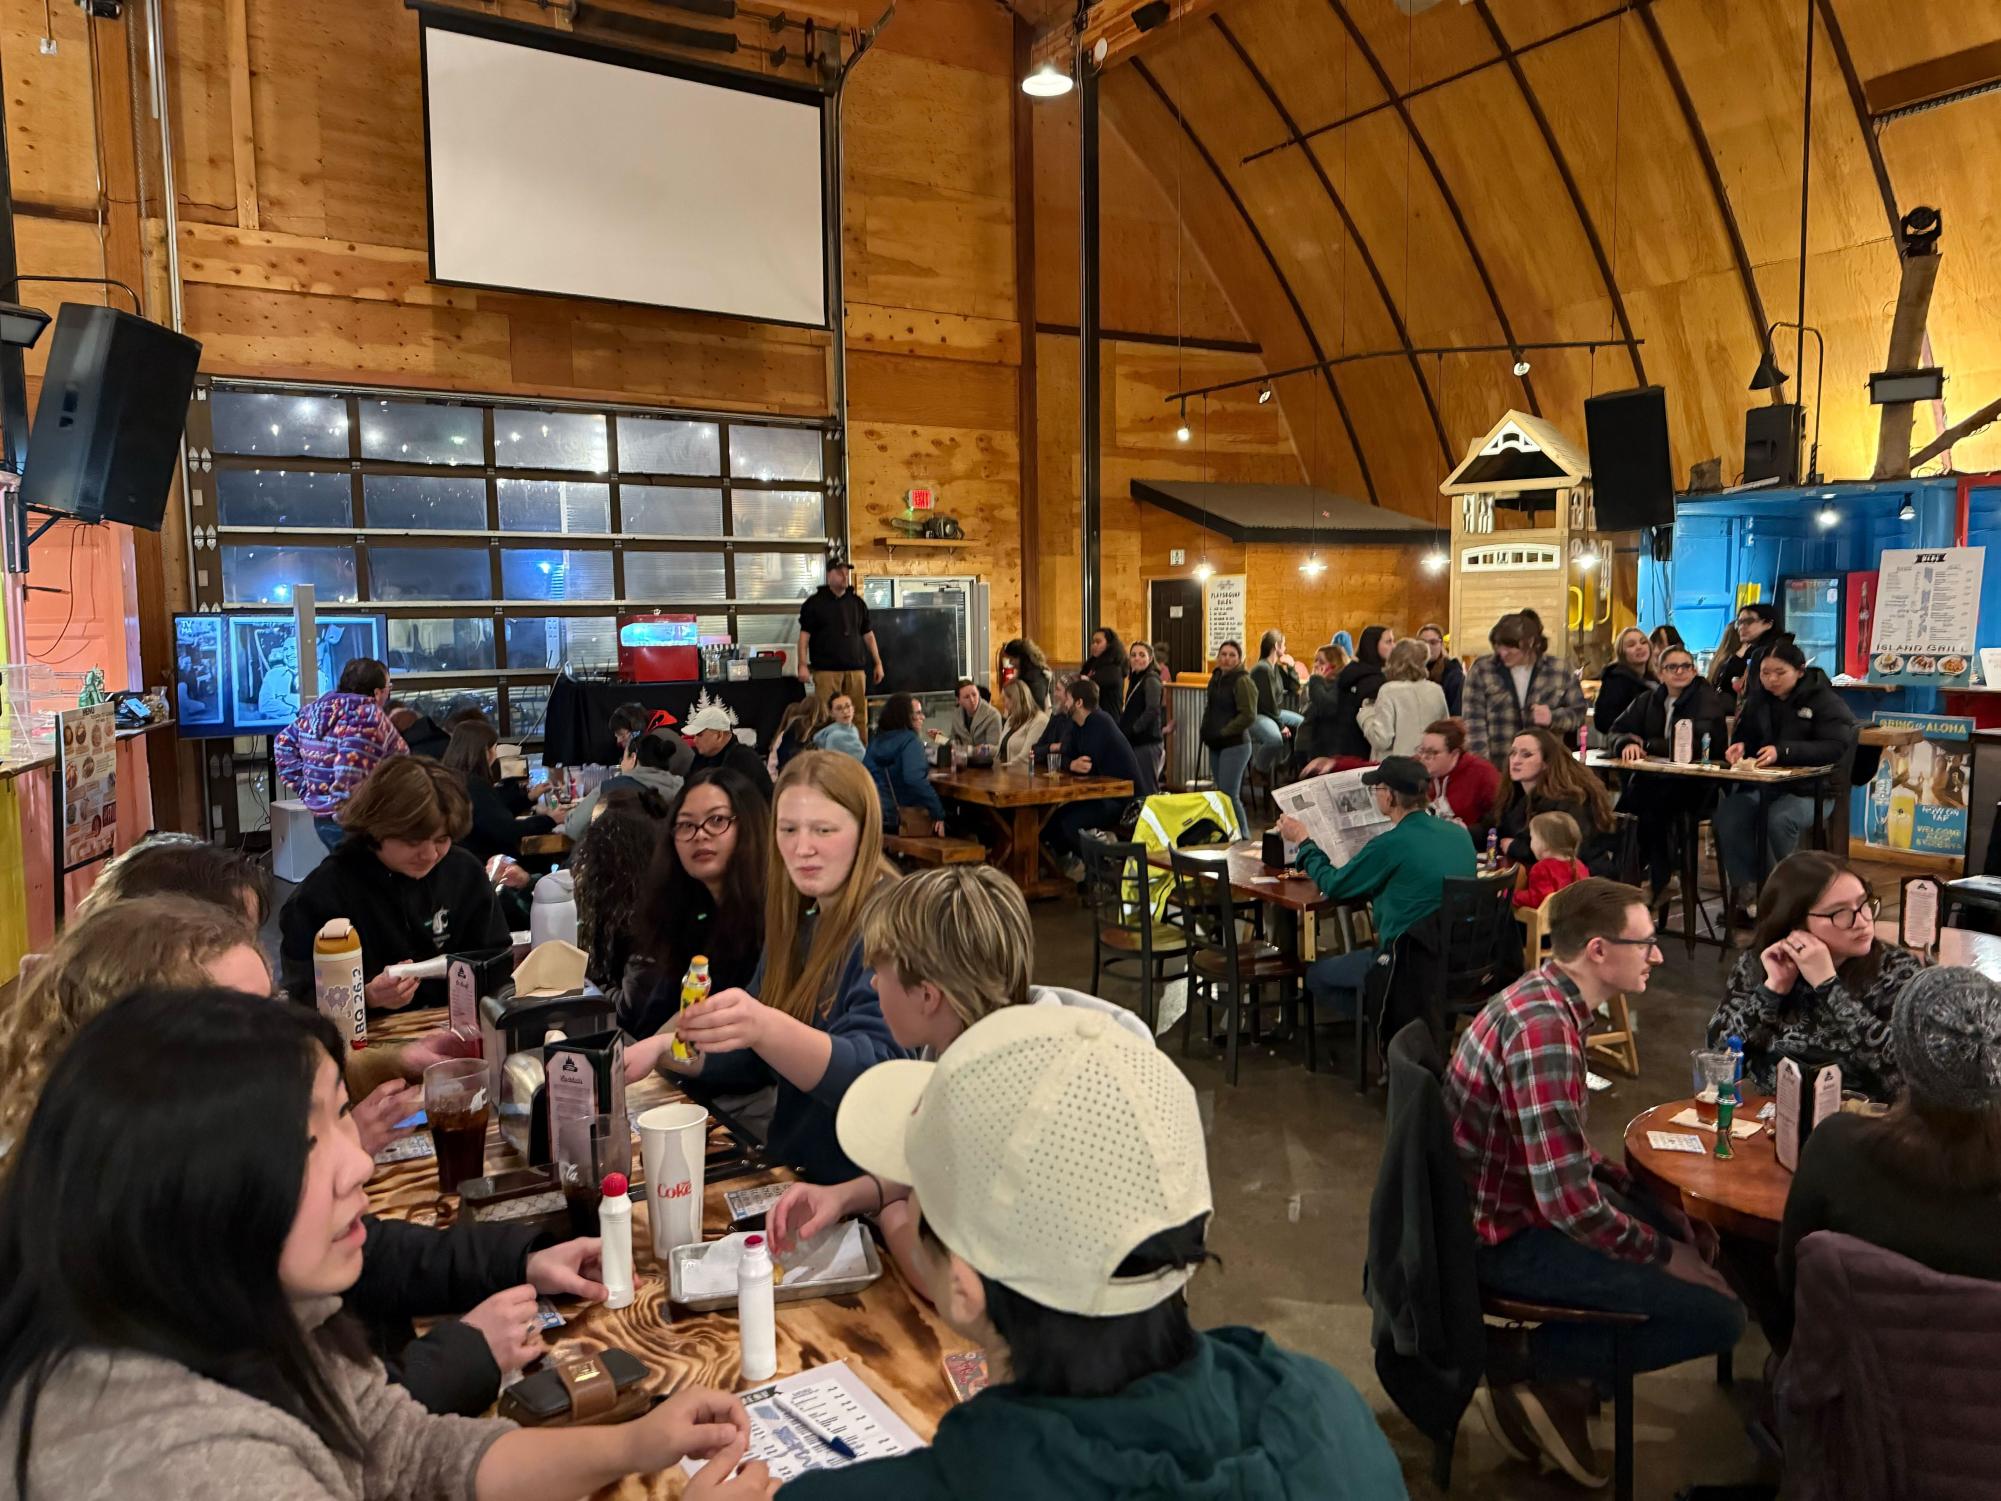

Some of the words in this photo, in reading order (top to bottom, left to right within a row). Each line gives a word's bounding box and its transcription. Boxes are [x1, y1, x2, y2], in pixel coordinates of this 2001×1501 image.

[912, 490, 931, 509] EXIT
[1876, 643, 1922, 652] ISLAND
[1926, 722, 1967, 734] ALOHA
[352, 967, 363, 1004] 26.2
[657, 1180, 692, 1199] Coke
